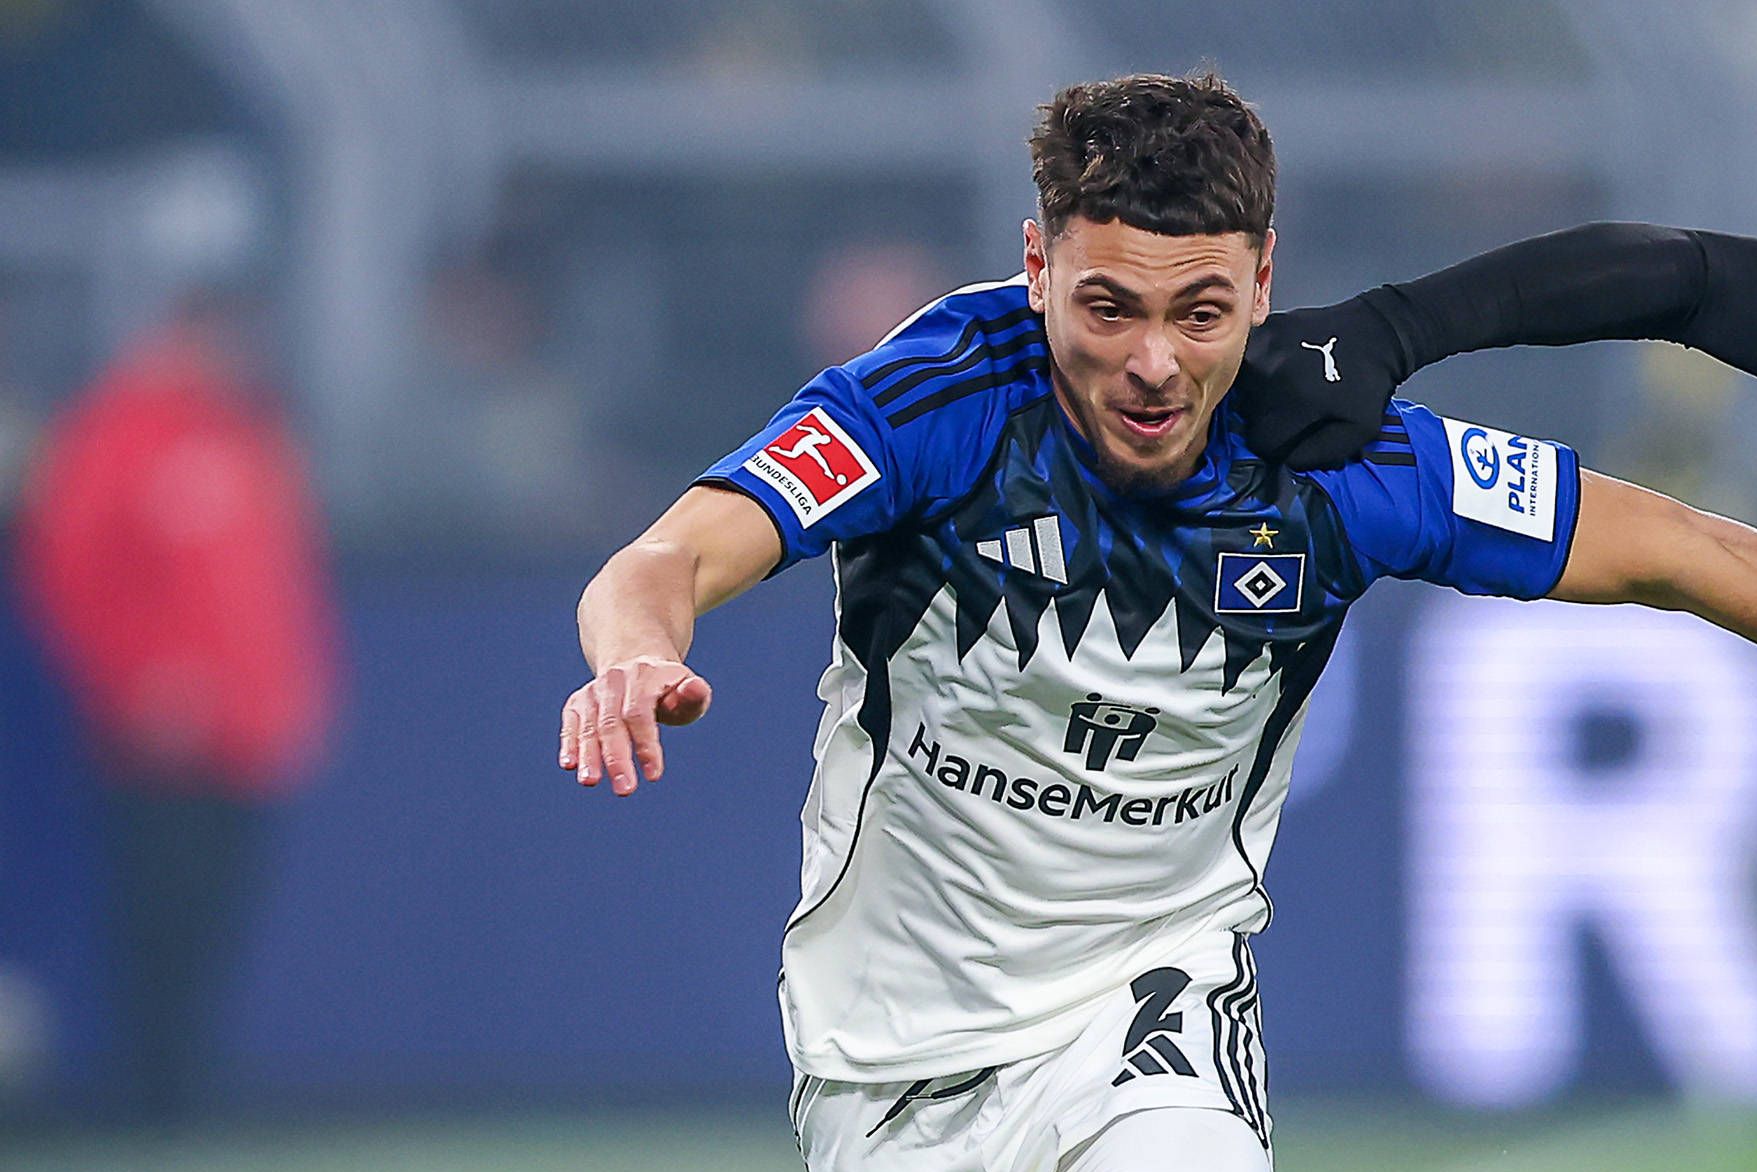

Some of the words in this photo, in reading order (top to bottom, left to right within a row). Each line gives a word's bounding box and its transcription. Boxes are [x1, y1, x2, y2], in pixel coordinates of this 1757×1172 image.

[751, 454, 812, 516] BUNDESLIGA
[1529, 443, 1540, 517] INTERNATION
[907, 721, 1240, 827] HanseMerkur
